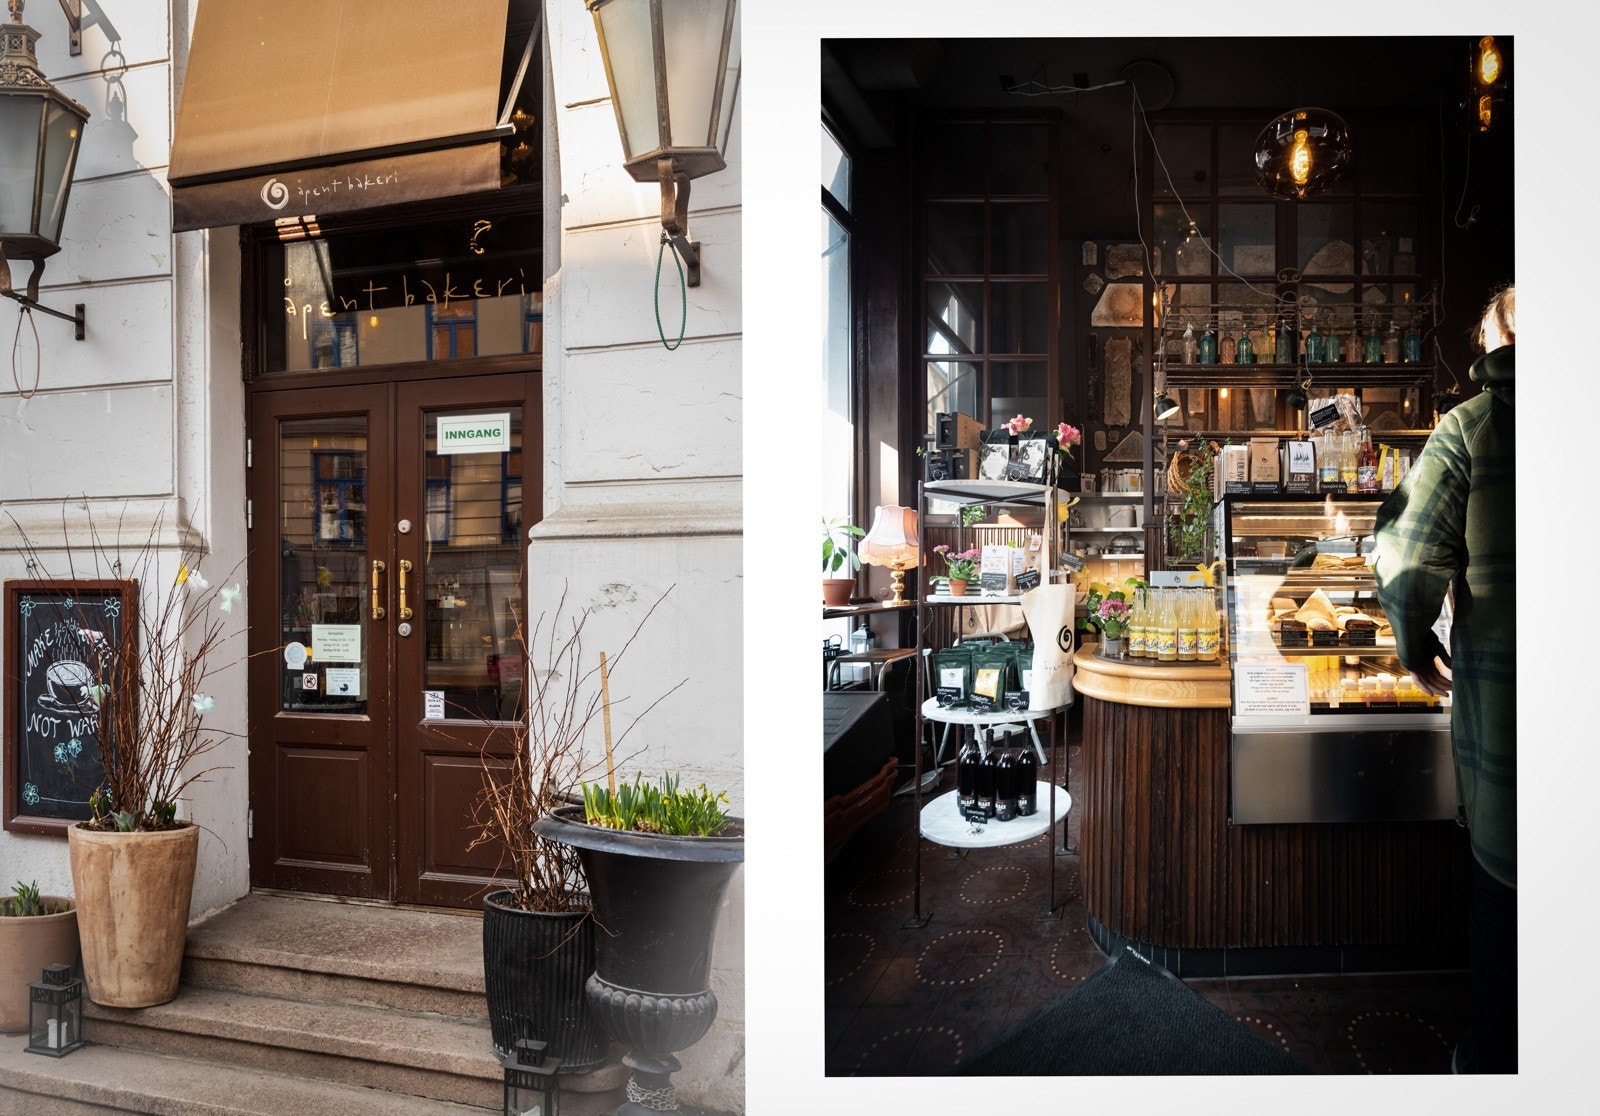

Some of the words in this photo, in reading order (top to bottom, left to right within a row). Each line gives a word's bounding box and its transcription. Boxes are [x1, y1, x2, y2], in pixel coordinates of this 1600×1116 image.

[297, 178, 342, 205] åpent
[347, 171, 398, 190] bakeri
[284, 276, 388, 340] åpent
[403, 267, 525, 309] bakeri
[445, 428, 501, 440] INNGANG
[27, 628, 54, 676] MAKE
[27, 712, 61, 738] NOT
